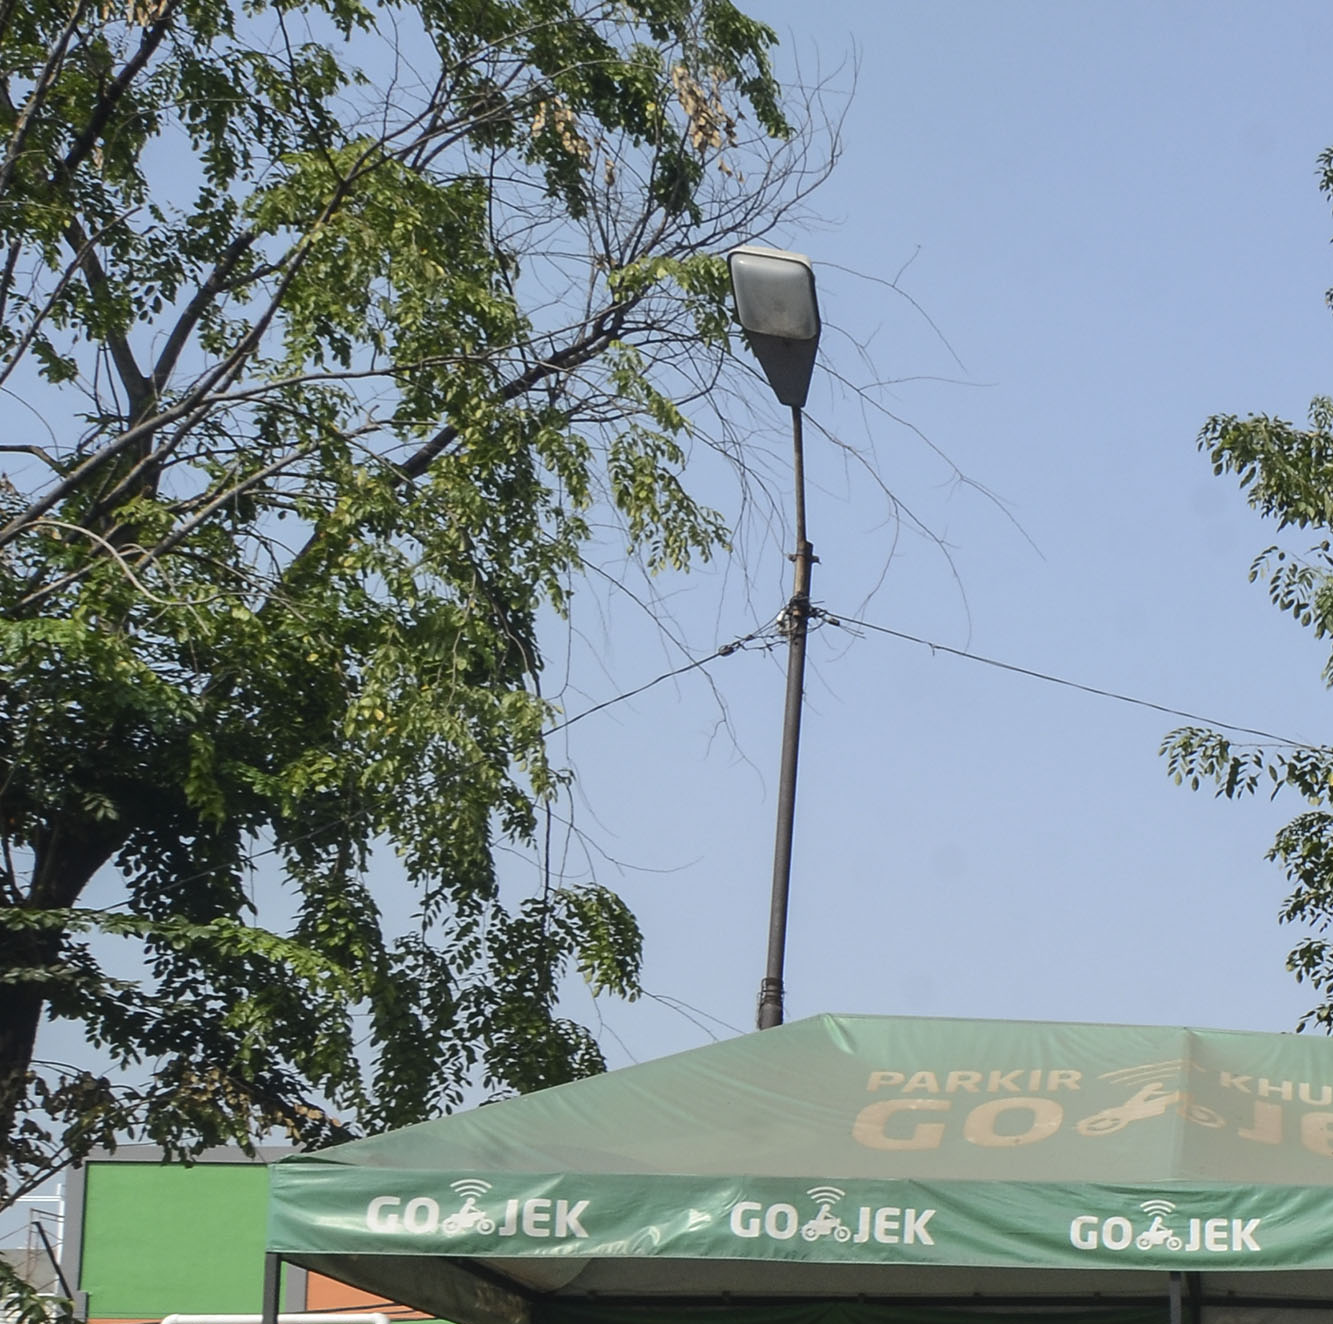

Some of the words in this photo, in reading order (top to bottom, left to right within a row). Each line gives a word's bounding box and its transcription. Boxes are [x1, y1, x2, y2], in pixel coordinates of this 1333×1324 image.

[866, 1069, 1082, 1093] PARKIR
[851, 1096, 1064, 1151] GO
[366, 1195, 440, 1236] GO
[497, 1198, 591, 1239] JEK
[730, 1200, 798, 1240] GO
[853, 1206, 937, 1245] JEK
[1070, 1215, 1132, 1250] GO
[1184, 1217, 1262, 1253] JEK
